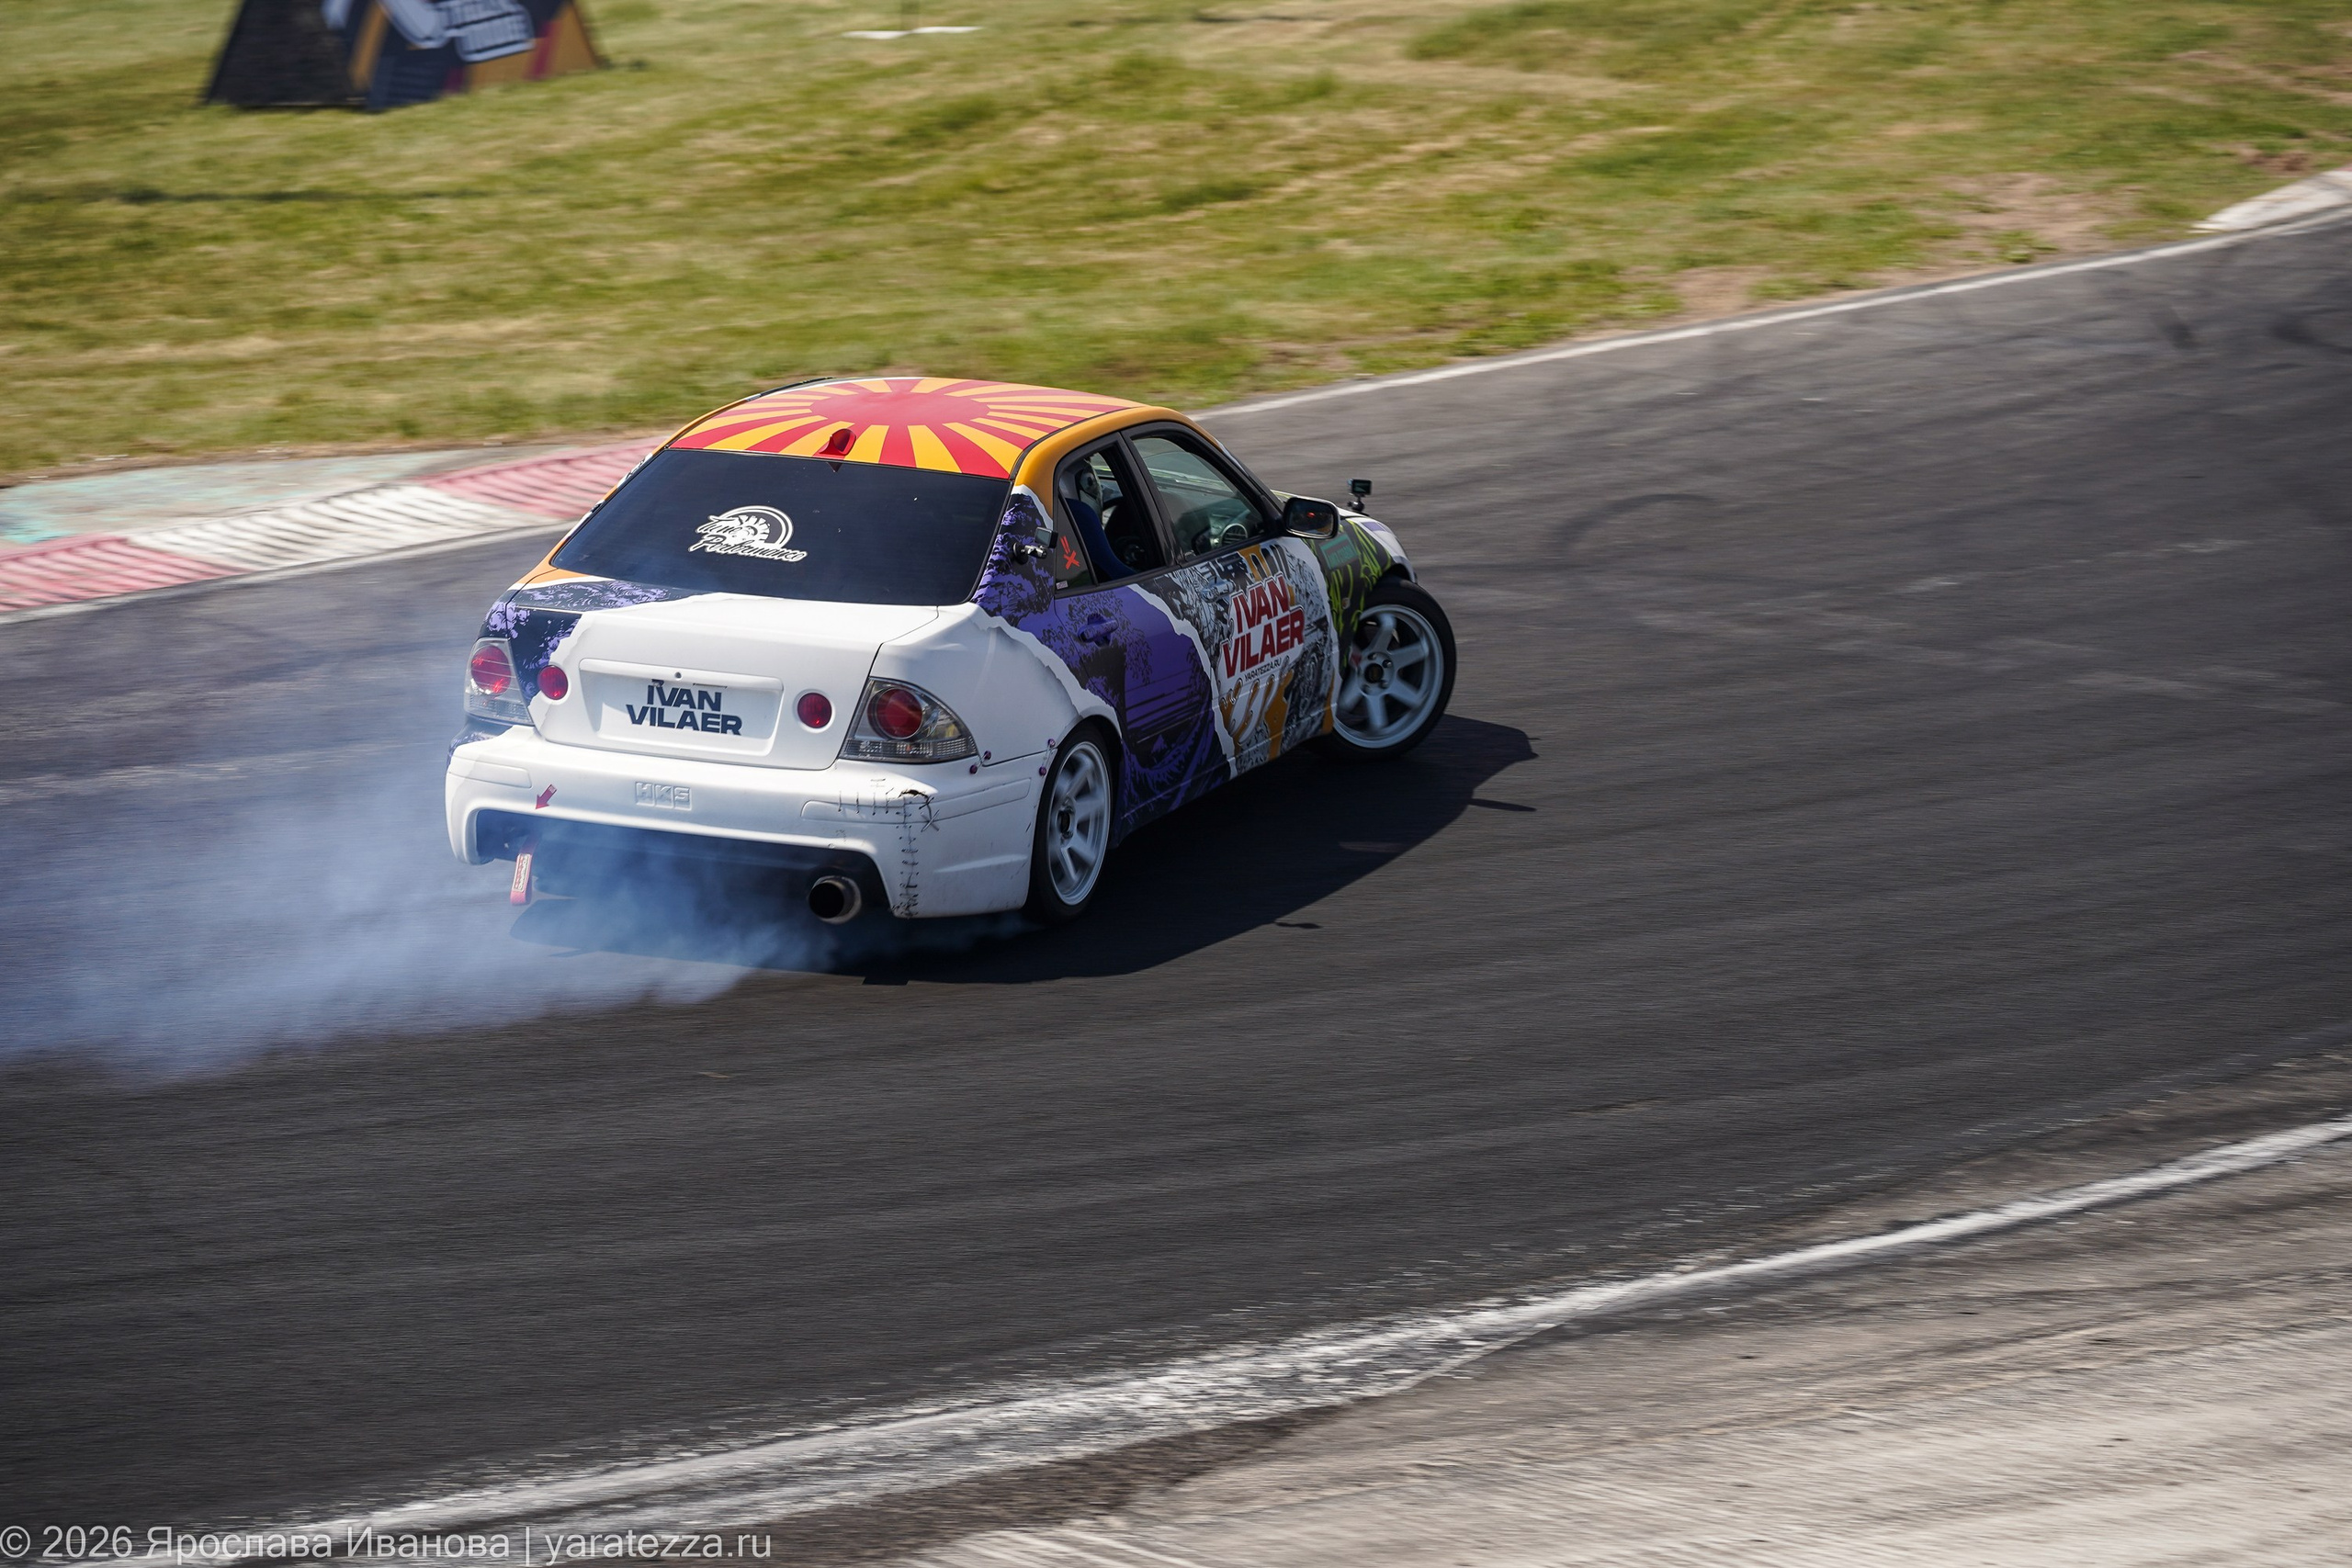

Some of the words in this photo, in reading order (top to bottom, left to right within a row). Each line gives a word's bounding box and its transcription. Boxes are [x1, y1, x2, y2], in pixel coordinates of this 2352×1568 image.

[688, 534, 808, 562] Performance
[1232, 575, 1290, 635] IVAN
[1222, 608, 1305, 679] VILAER
[1244, 657, 1283, 682] YARATEZZA.RU
[647, 684, 722, 712] IVAN
[626, 704, 743, 736] VILAER
[635, 782, 693, 811] HKS
